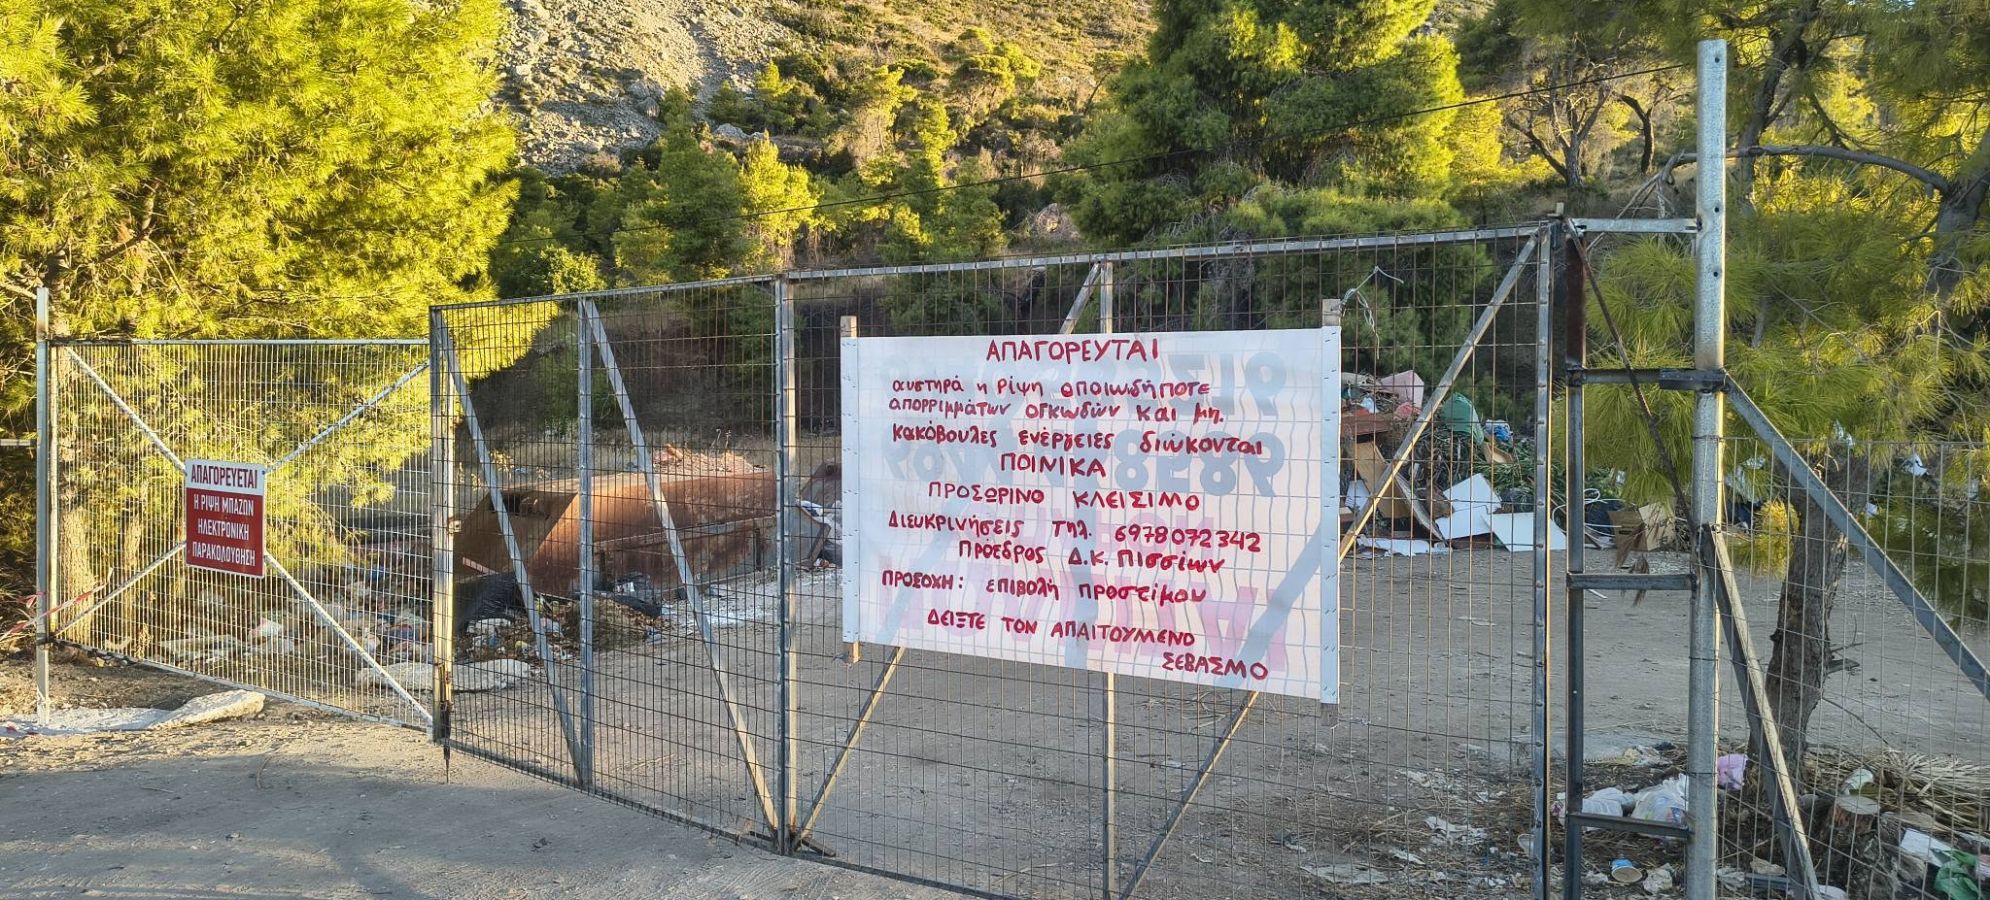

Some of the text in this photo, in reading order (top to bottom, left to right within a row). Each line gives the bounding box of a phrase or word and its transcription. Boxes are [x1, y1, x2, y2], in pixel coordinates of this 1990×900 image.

[985, 338, 1160, 364] ΑΠΑΓΟΡΕΥΤΑΙ
[1018, 426, 1115, 452] ενέργειες
[1139, 429, 1263, 456] διώκονται
[191, 464, 258, 489] ΑΠΑΓΟΡΕΥΕΤΑΙ
[1000, 452, 1107, 478] ΠΟΙΝΙΚΑ
[193, 494, 254, 517] Η ΡΙΨΗ ΜΠΑΖΩΝ
[928, 481, 1201, 512] ΠΡΟΣΩΡΙΝΟ ΚΛΕΙΣΙΜΟ
[197, 518, 250, 541] ΗΛΕΚΤΡΟΝΙΚΗ
[1114, 524, 1262, 553] 6978072342
[192, 541, 256, 567] ΠΑΡΑΚΟΛΟΥΘΗΣΗ
[958, 537, 1047, 564] Πρόεδρος
[1117, 549, 1226, 574] Πισσίων
[927, 608, 1196, 647] ΔΕΙΞΤΕ ΤΟΝ ΑΠΑΙΤΟΥΜΕΝΟ
[1161, 651, 1269, 681] ΣΕΒΑΣΜΟ
